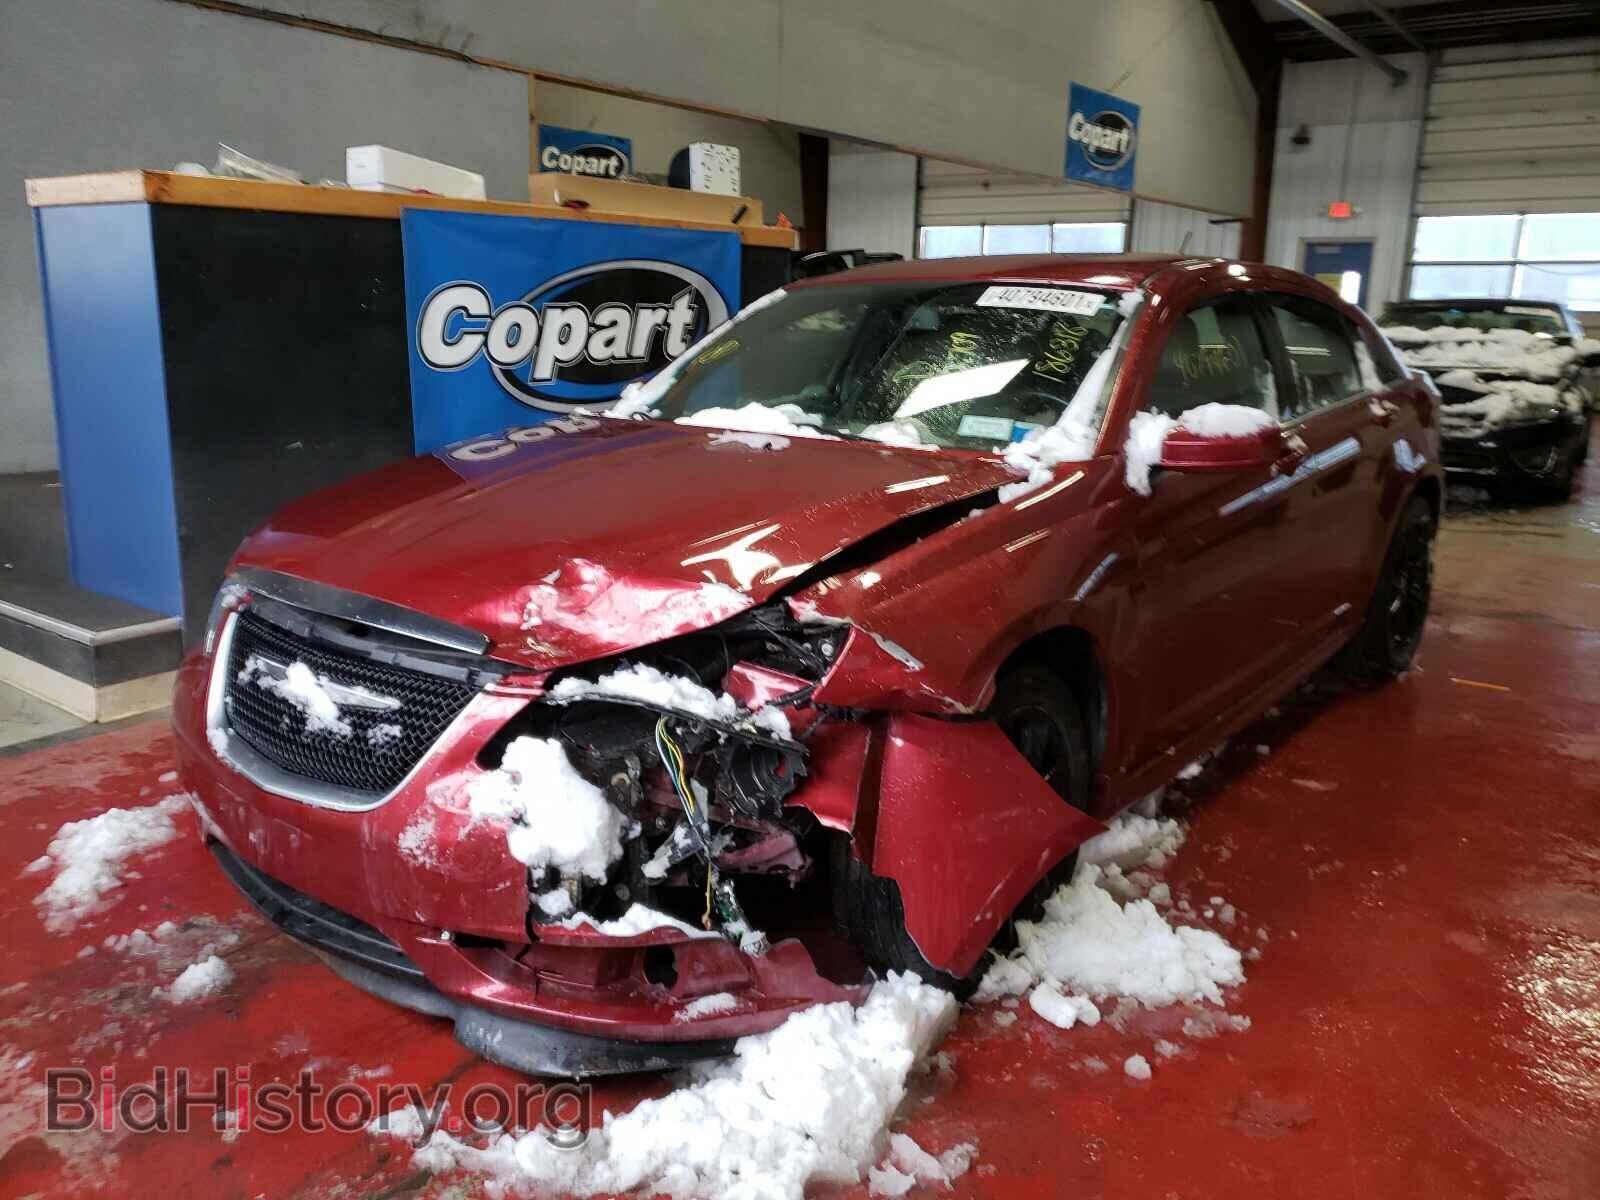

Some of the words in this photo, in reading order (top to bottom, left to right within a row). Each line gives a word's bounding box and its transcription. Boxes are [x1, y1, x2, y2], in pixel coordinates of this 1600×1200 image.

[1069, 111, 1129, 153] Copart
[541, 146, 619, 177] Copart
[417, 280, 699, 385] Copart
